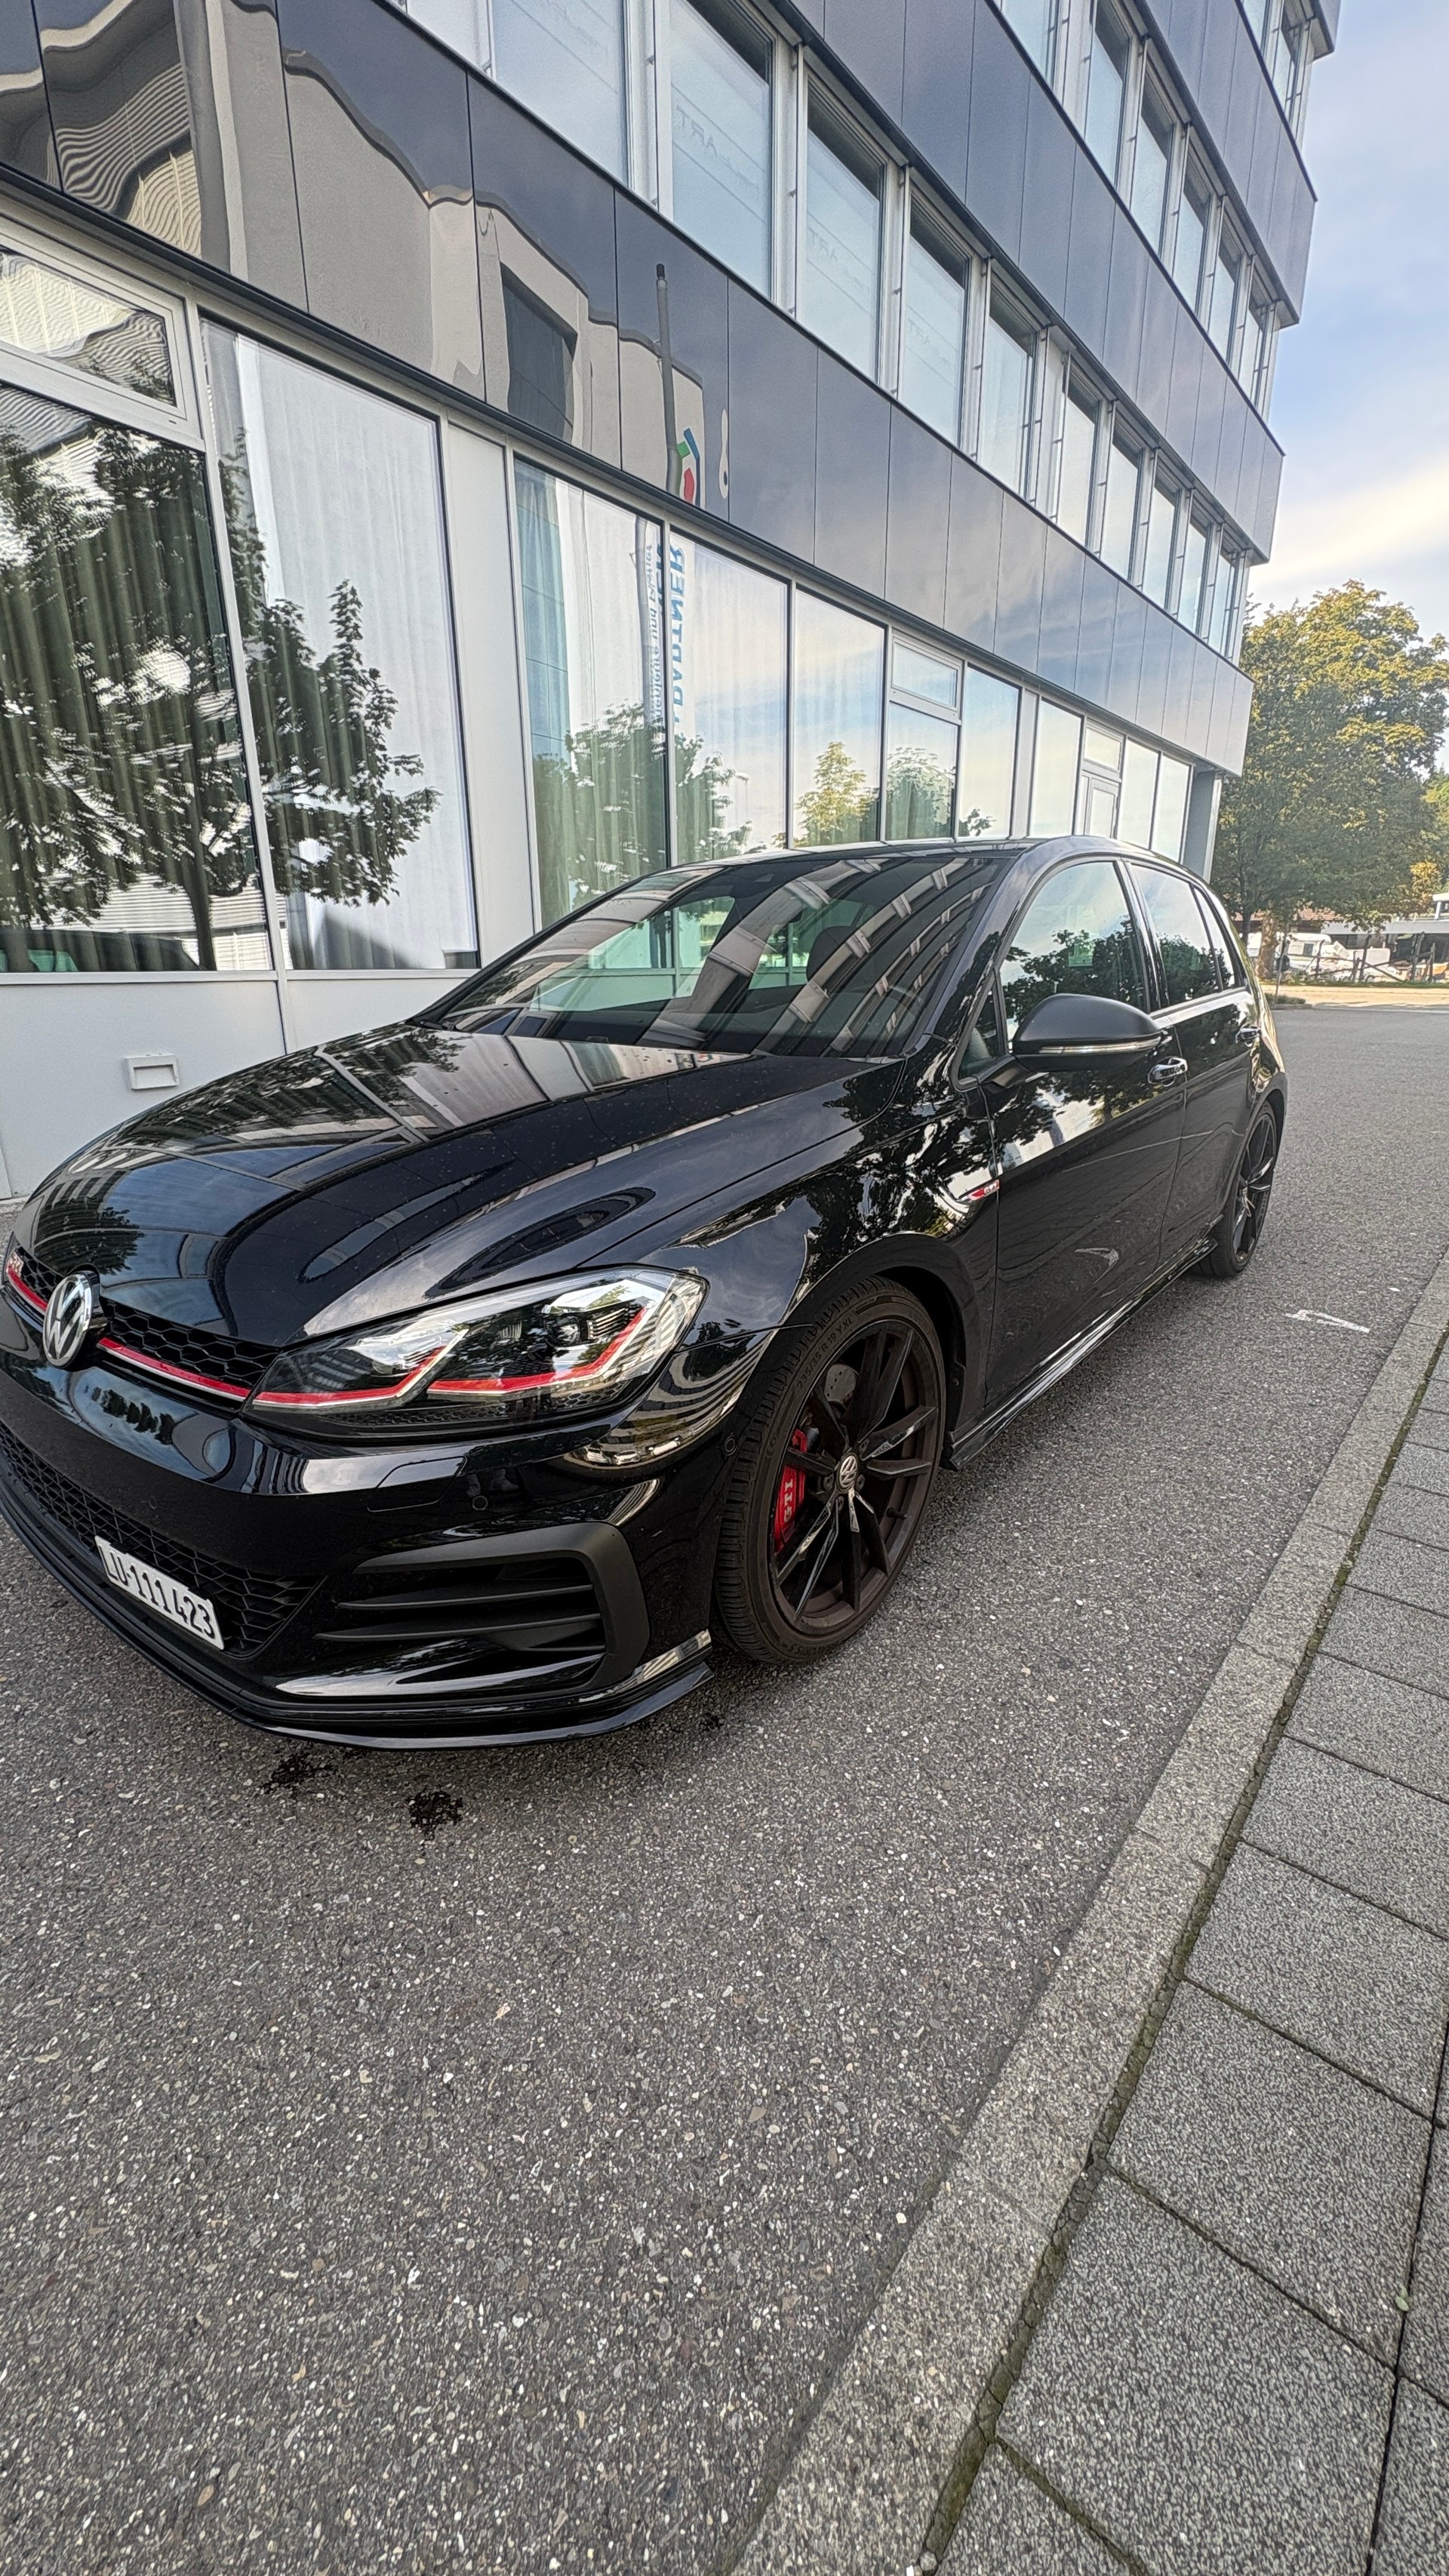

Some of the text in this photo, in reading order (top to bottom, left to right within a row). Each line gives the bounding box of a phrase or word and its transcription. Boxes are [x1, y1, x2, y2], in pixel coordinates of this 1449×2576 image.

[797, 1352, 822, 1388] 235/35
[827, 1332, 836, 1343] 19
[842, 1317, 854, 1327] XL
[784, 1479, 794, 1523] GTI
